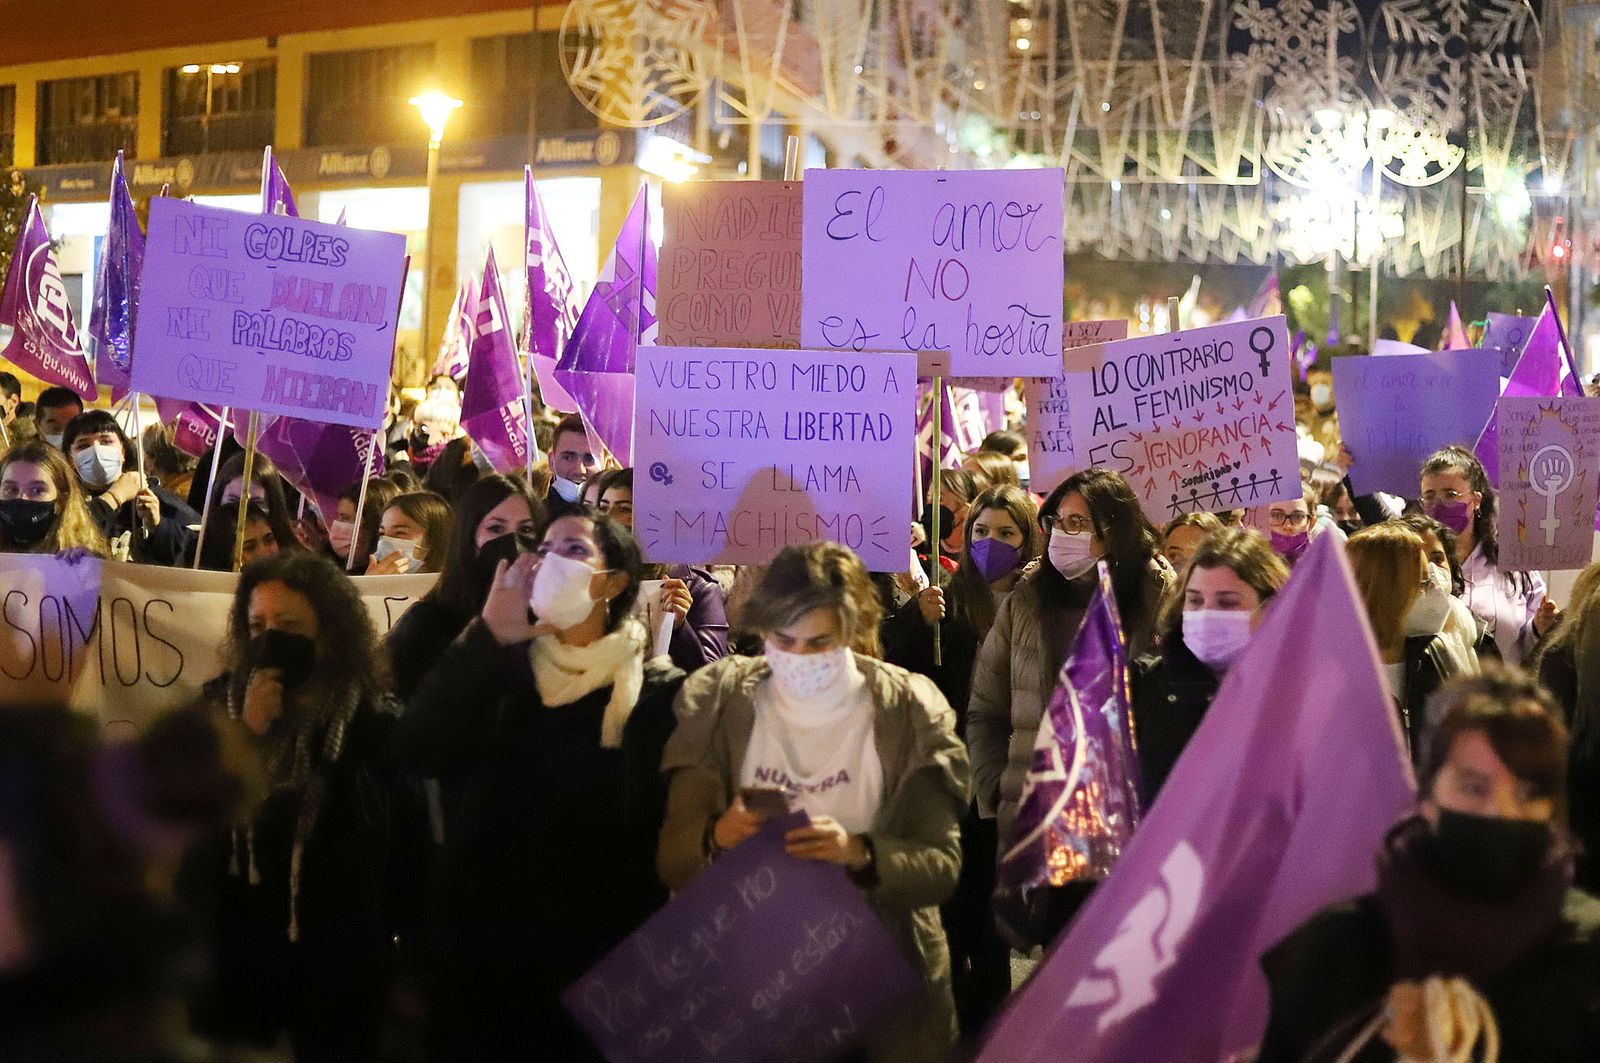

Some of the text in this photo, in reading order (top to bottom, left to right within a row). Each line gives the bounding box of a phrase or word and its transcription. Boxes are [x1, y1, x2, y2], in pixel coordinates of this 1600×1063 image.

[173, 214, 349, 267] NI GOLPES
[674, 195, 802, 242] NADIE
[826, 186, 1057, 253] El amor
[188, 264, 245, 304] QUE
[904, 257, 970, 302] NO
[167, 306, 356, 361] NI PALABRAS
[666, 292, 752, 333] COMO
[818, 303, 1058, 357] es la hostia
[177, 353, 378, 418] QUE HIERAN
[649, 360, 899, 394] VUESTRO MIEDO A
[1091, 340, 1234, 398] LO CONTRARIO
[649, 408, 893, 442] NUESTRA LIBERTAD
[1092, 371, 1254, 436] AL FEMINISMO
[1143, 411, 1273, 471] IGNORANCIA
[701, 461, 862, 493] SE LLAMA
[674, 505, 864, 550] MACHISMO
[1, 590, 184, 687] SOMOS
